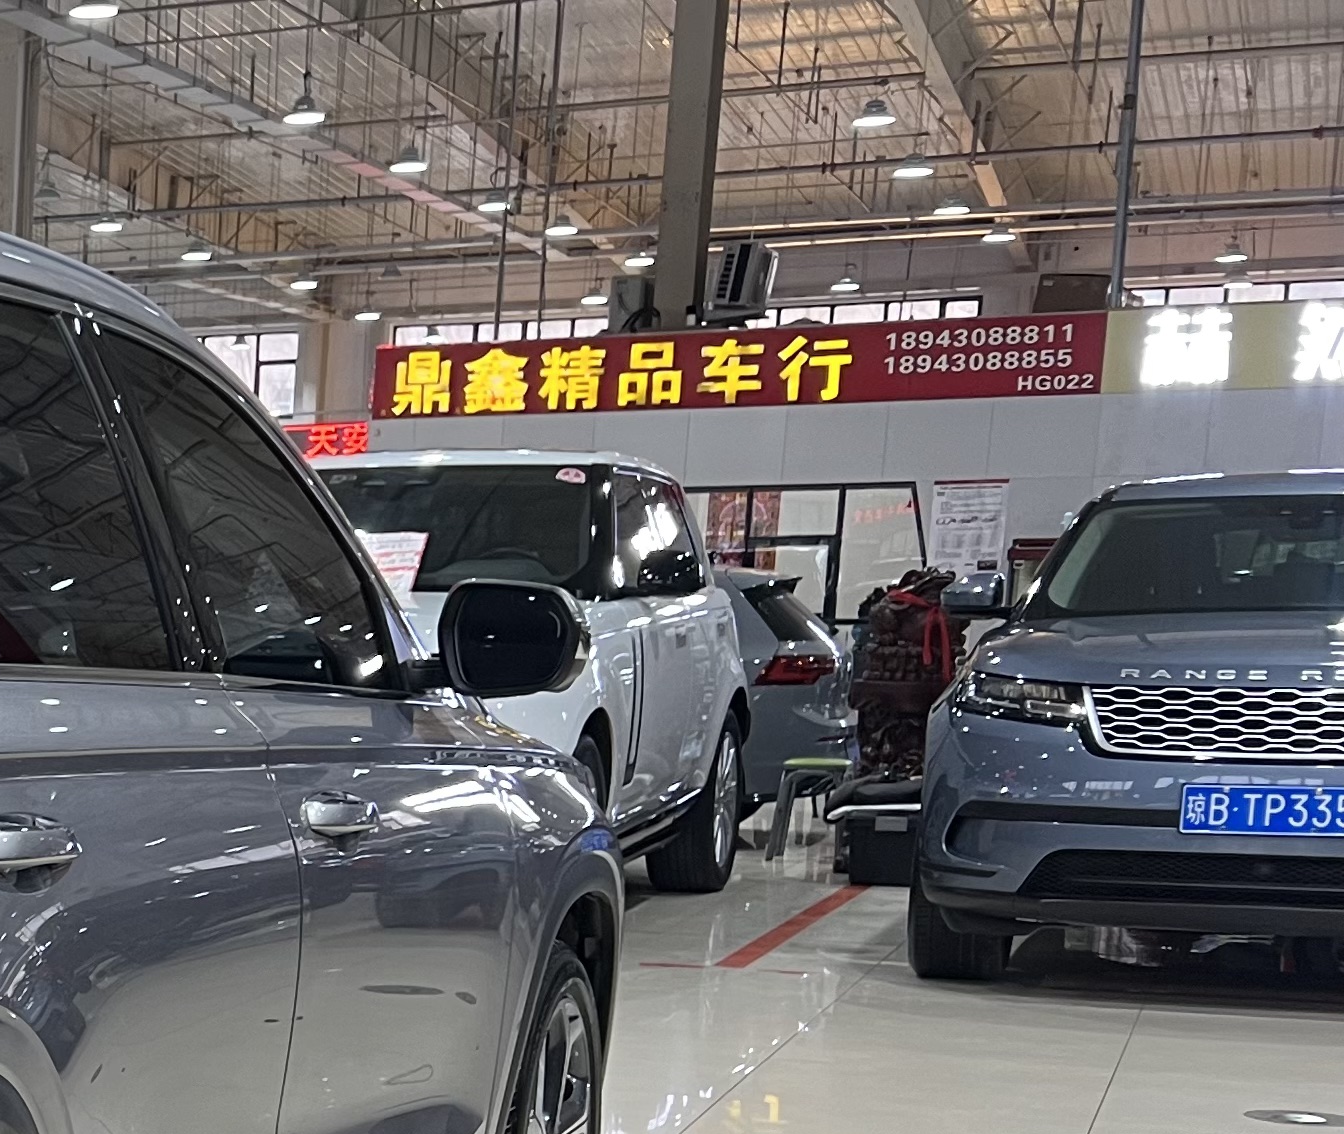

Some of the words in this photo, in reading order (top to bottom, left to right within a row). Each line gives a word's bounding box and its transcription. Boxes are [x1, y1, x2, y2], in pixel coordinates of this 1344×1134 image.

[885, 323, 1074, 350] 18943088811
[883, 348, 1073, 374] 18943088855
[392, 335, 853, 417] 鼎鑫精品车行
[1016, 373, 1095, 392] HG022
[1119, 668, 1268, 681] RANGE
